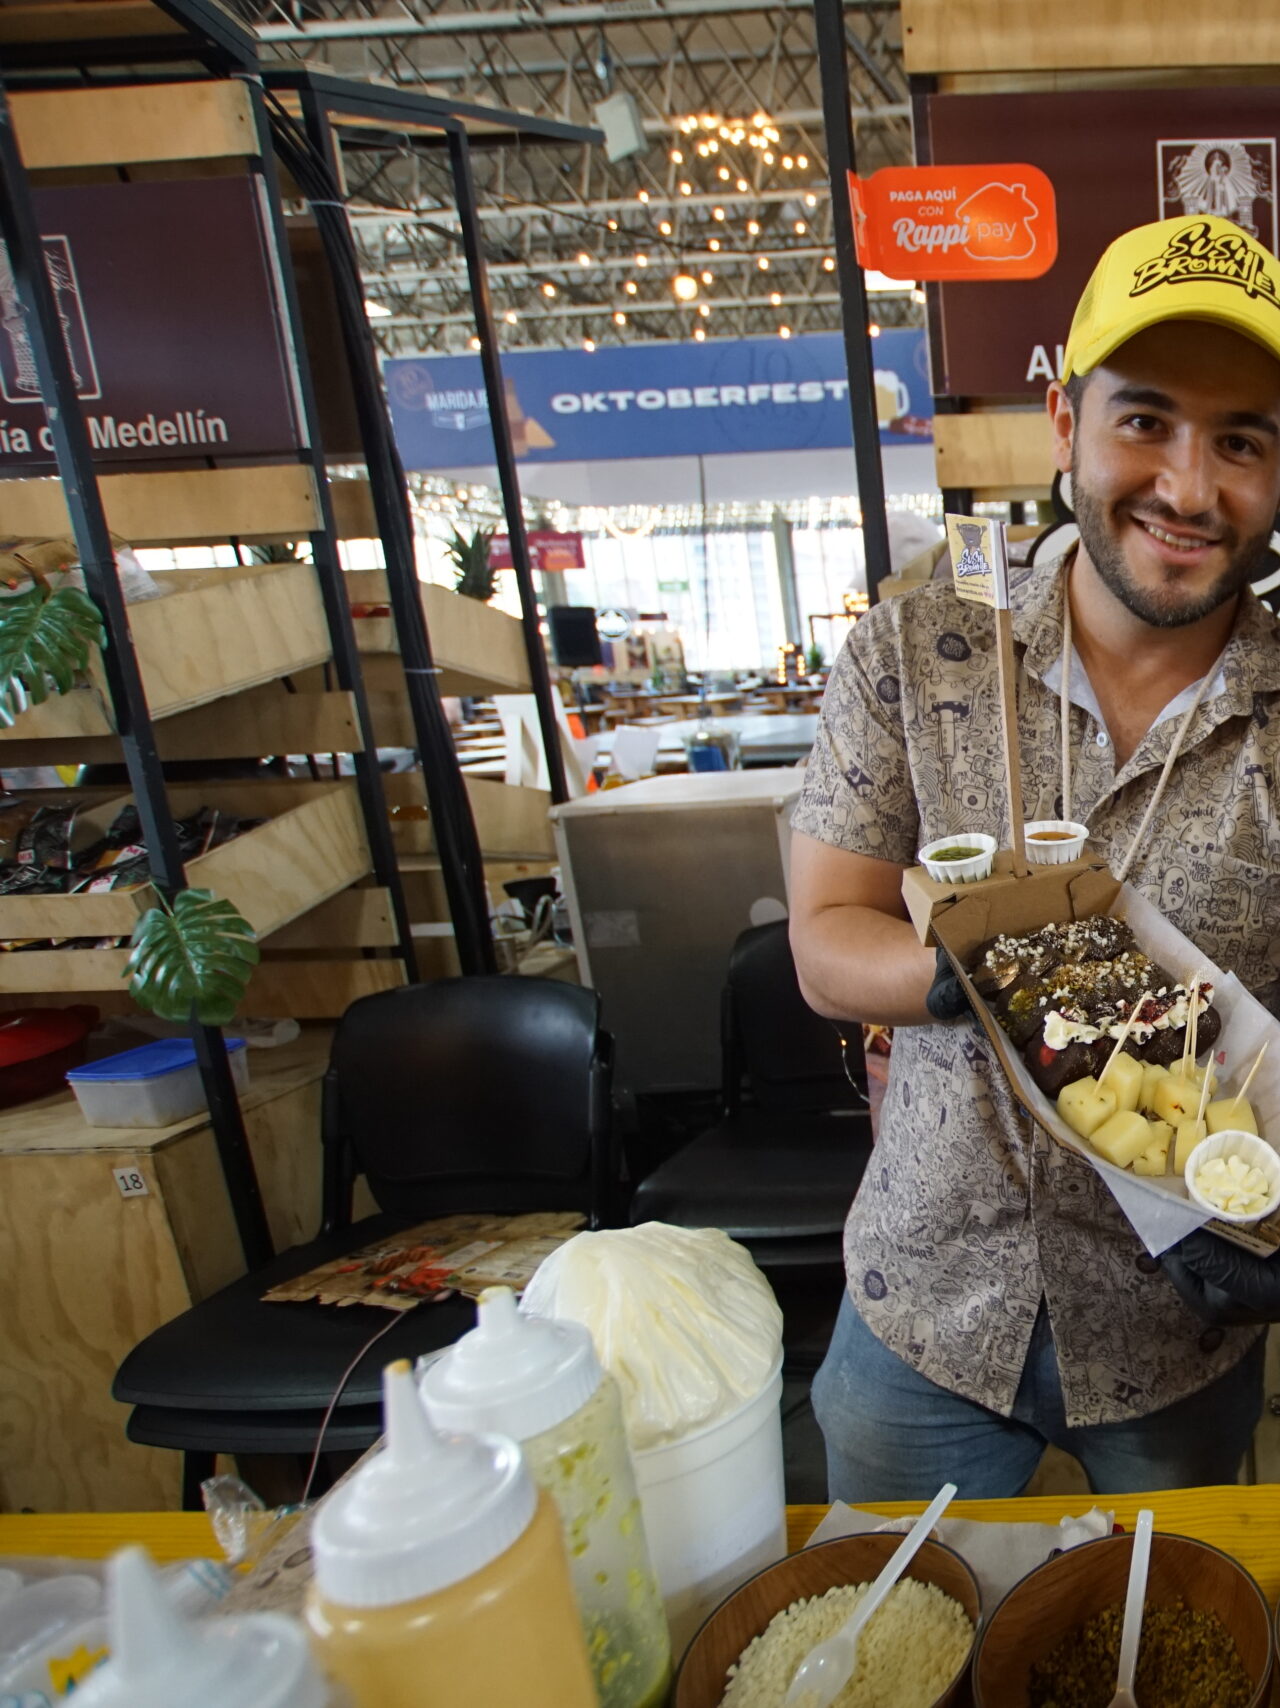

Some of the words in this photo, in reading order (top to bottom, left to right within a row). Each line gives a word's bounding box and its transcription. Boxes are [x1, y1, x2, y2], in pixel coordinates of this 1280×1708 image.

[889, 190, 922, 201] PAGA
[925, 187, 957, 202] AQUÍ
[918, 206, 944, 216] CON
[893, 215, 970, 253] Rappi
[977, 221, 1017, 241] pay
[551, 379, 850, 414] OKTOBERFEST
[86, 409, 229, 449] Medellín
[119, 1173, 144, 1191] 18
